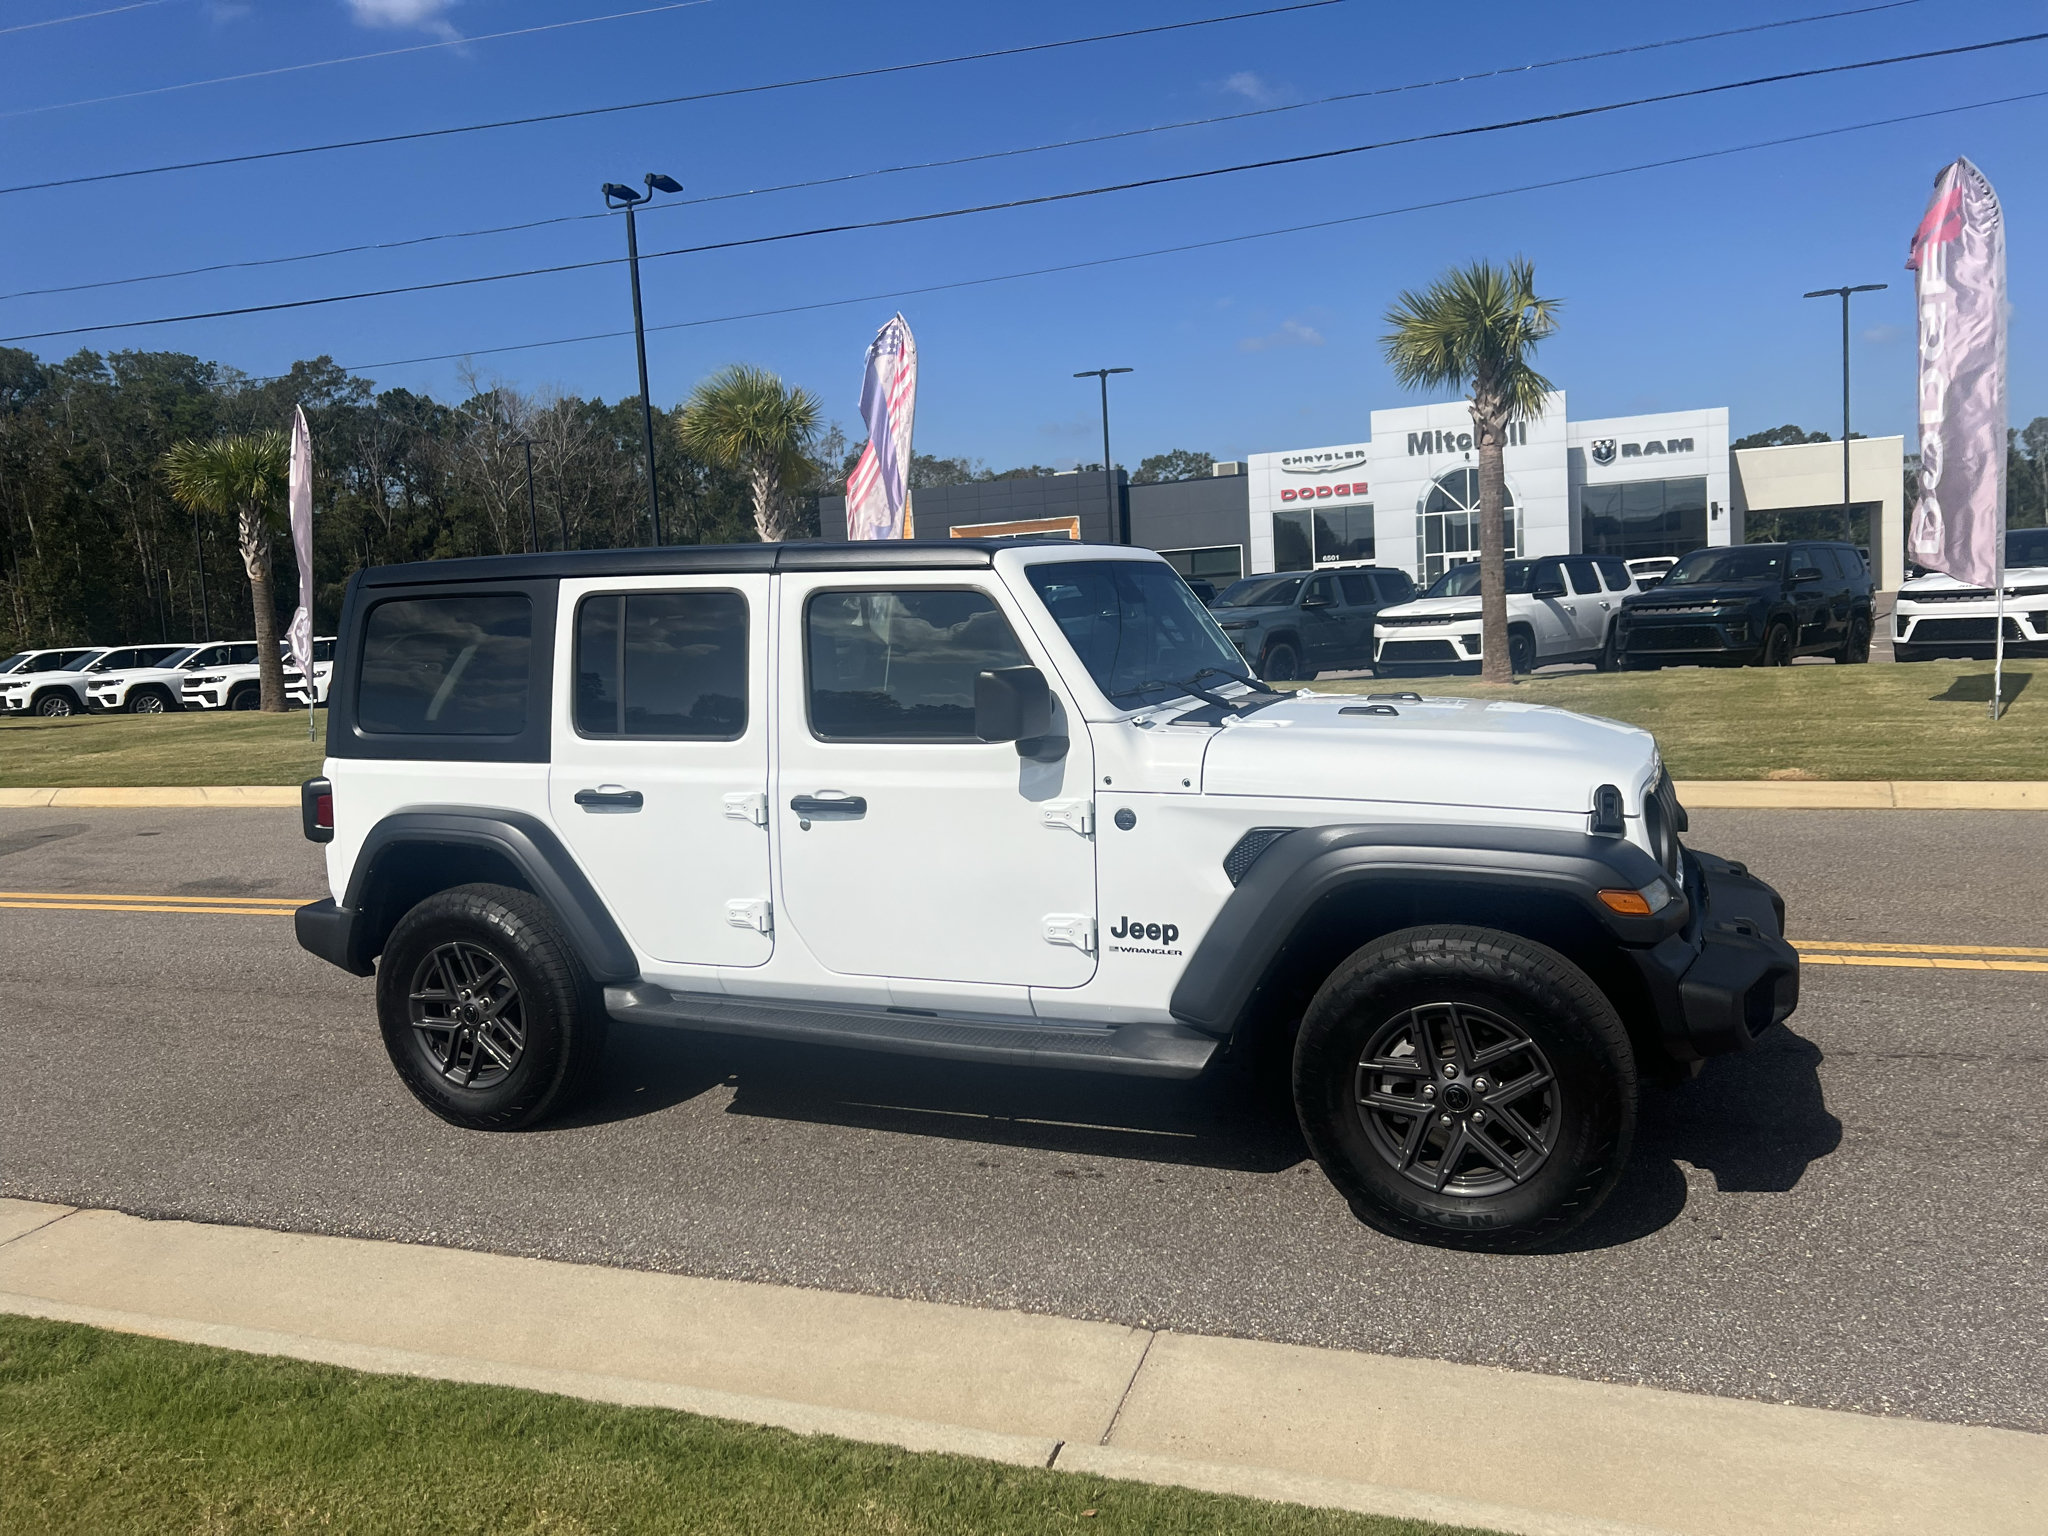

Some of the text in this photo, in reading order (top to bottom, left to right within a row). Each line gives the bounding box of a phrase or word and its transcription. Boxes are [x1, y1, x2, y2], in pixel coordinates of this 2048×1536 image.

[1407, 421, 1527, 456] Mitcll
[1620, 438, 1695, 458] RAM
[1281, 450, 1366, 466] CHRYSLER
[1280, 482, 1369, 501] DODGE
[1322, 554, 1340, 562] 6501
[1111, 916, 1179, 945] Jeep
[1120, 946, 1183, 956] WRANGLER
